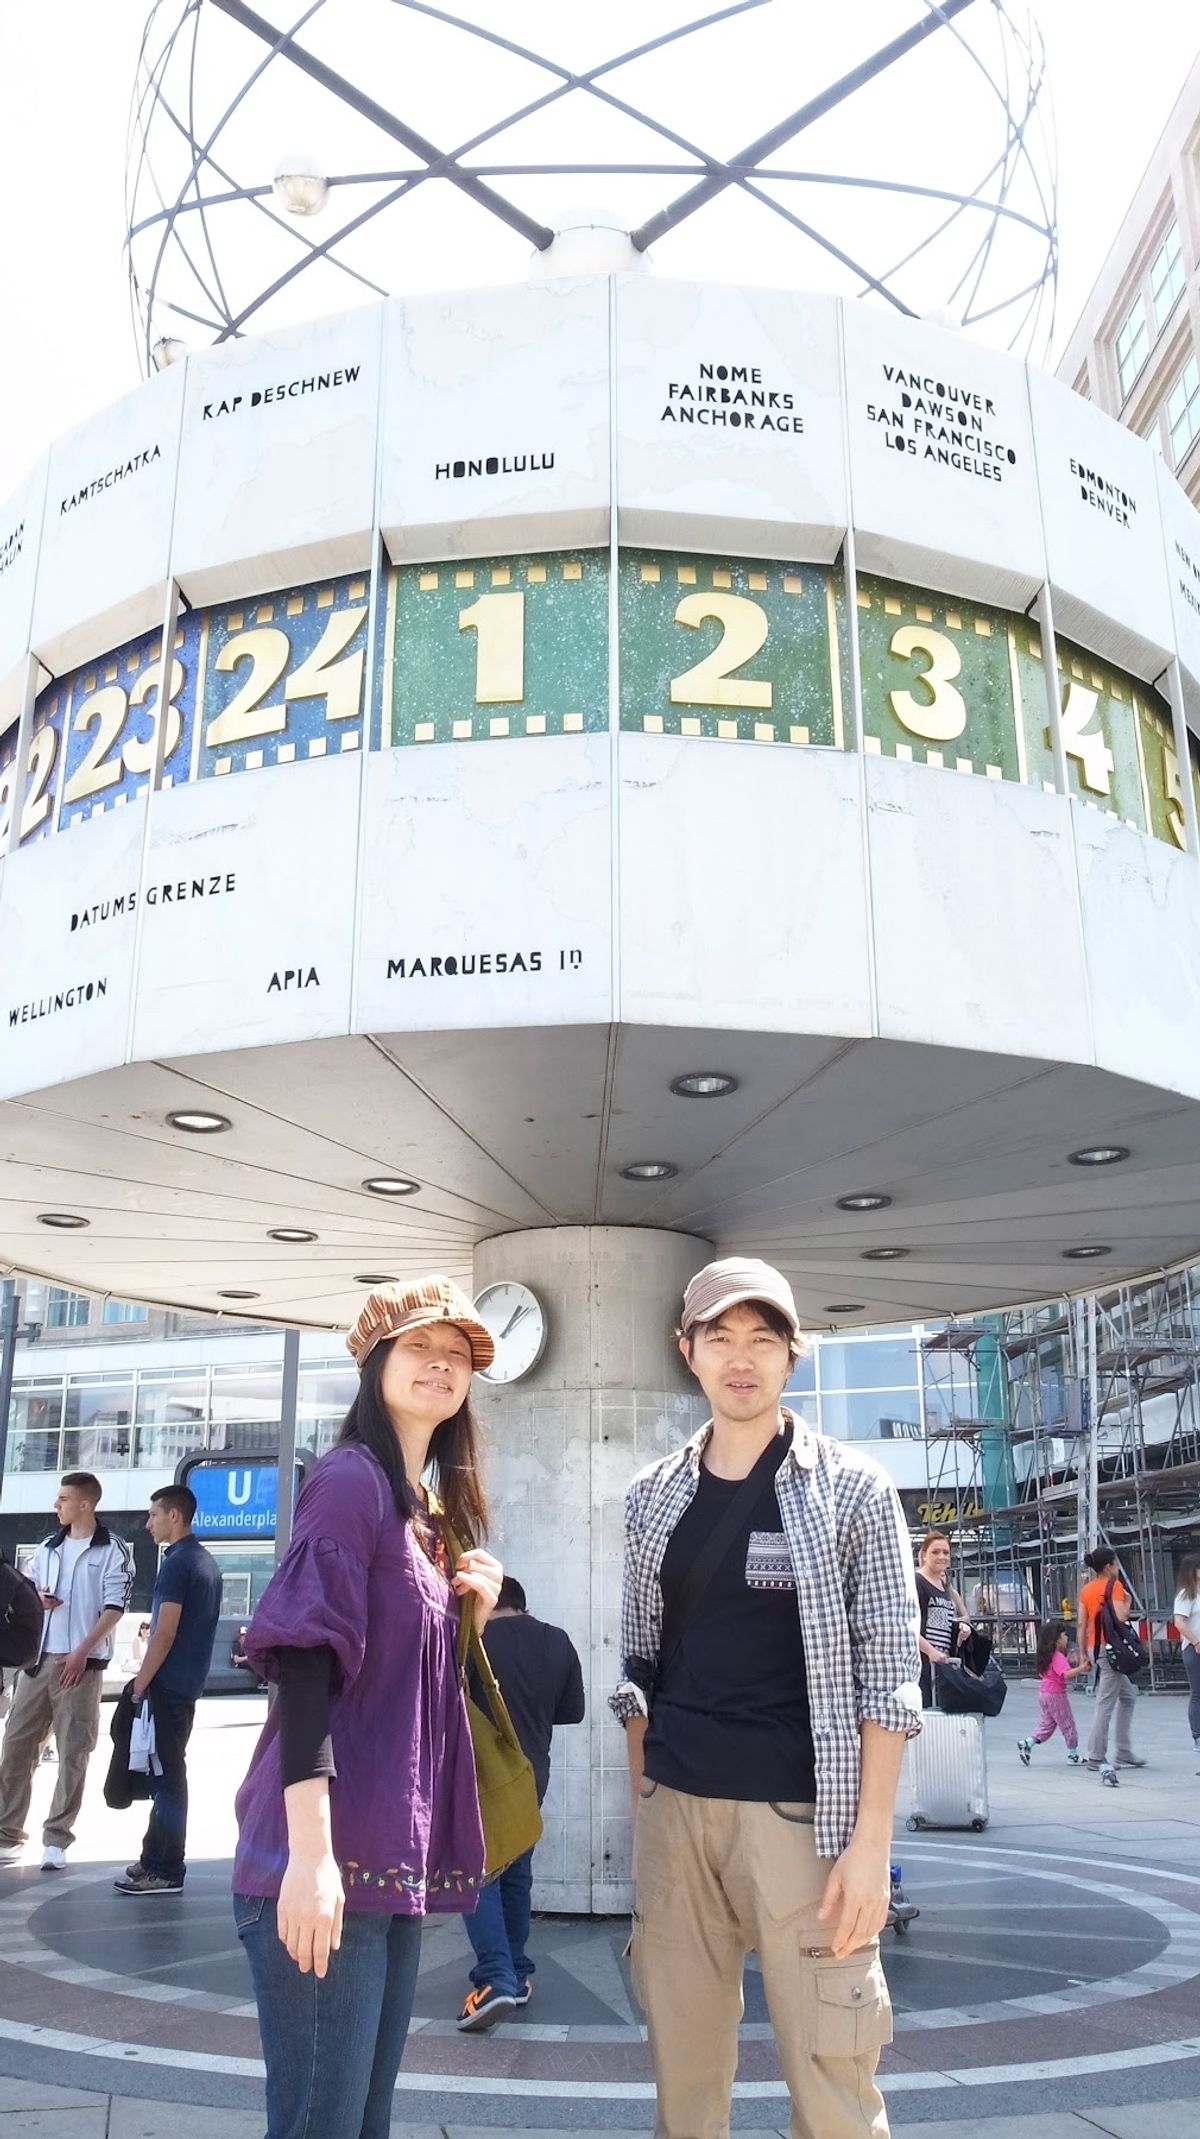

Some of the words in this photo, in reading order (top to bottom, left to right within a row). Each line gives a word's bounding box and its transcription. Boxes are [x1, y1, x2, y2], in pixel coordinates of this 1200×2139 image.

[202, 396, 243, 420] KAP
[251, 366, 361, 407] DESCHNEW
[668, 382, 794, 410] FAIRBANKS
[700, 363, 762, 384] NOME
[883, 364, 996, 416] VANCOUVER
[660, 405, 804, 434] ANCHORAGE
[867, 404, 904, 429] SAN
[914, 418, 1017, 465] FRANCISCO
[901, 392, 982, 432] DAWSON
[60, 444, 161, 516] KAMTSCHATKA
[435, 453, 555, 480] HONOLULU
[885, 432, 917, 455] LOS
[924, 445, 1002, 482] ANGELES
[1069, 457, 1137, 514] EDMONTON
[1080, 484, 1131, 529] DENVER
[458, 591, 525, 704] 1
[670, 592, 773, 709] 2
[206, 605, 368, 748] 24
[886, 625, 968, 742] 3
[61, 659, 186, 804] 23
[1043, 681, 1115, 797] 4
[69, 892, 137, 932] DATUMS
[146, 873, 236, 905] GRENZE
[266, 966, 320, 993] APIA
[387, 951, 542, 979] MARQUESAS
[9, 977, 108, 1027] WELLINGTON
[227, 1470, 252, 1506] U
[191, 1510, 277, 1530] Alexanderpla
